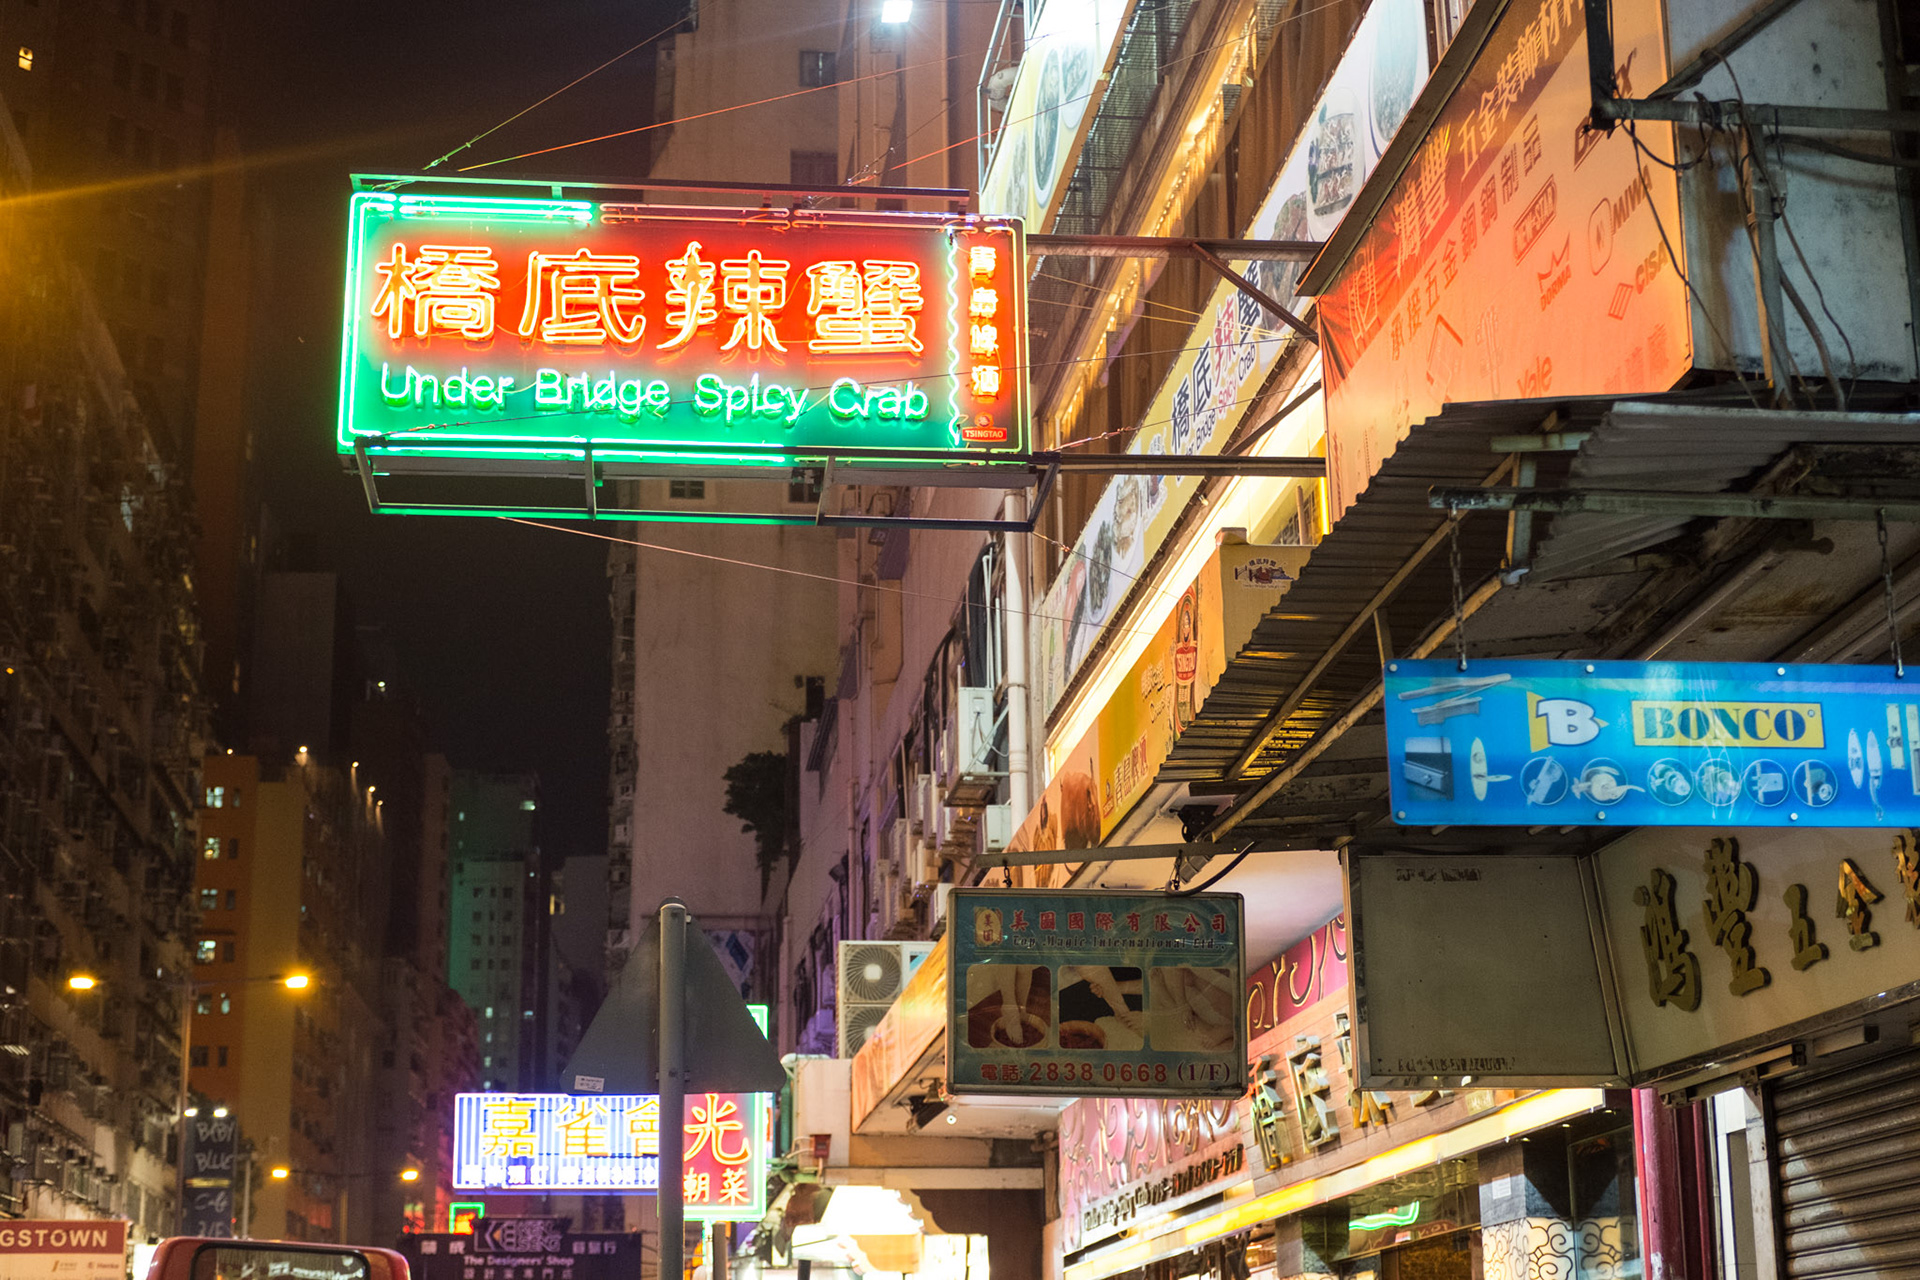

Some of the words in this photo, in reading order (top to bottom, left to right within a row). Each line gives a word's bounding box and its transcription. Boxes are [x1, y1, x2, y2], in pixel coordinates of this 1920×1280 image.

[1612, 164, 1653, 236] MIWA
[1540, 263, 1572, 312] DORMA
[1636, 238, 1668, 295] CISA
[370, 240, 925, 355] 橋底辣蟹
[1171, 259, 1260, 455] 橋底辣蟹
[1238, 342, 1256, 381] Crab
[380, 361, 514, 407] Under
[535, 367, 671, 417] Bridge
[693, 372, 810, 427] Spicy
[828, 376, 929, 421] Crab
[965, 429, 1004, 439] TSINGTAO
[1536, 698, 1601, 747] B
[1642, 706, 1808, 742] BONCO
[1013, 935, 1036, 947] Top
[1093, 936, 1186, 949] International
[1029, 1062, 1094, 1082] 2838
[1102, 1062, 1168, 1083] 0668
[1177, 1062, 1231, 1082] (1/F)
[684, 1092, 752, 1165] 光
[0, 1229, 108, 1248] GSTOWN
[464, 1255, 484, 1266] The
[546, 1255, 574, 1267] Shop
